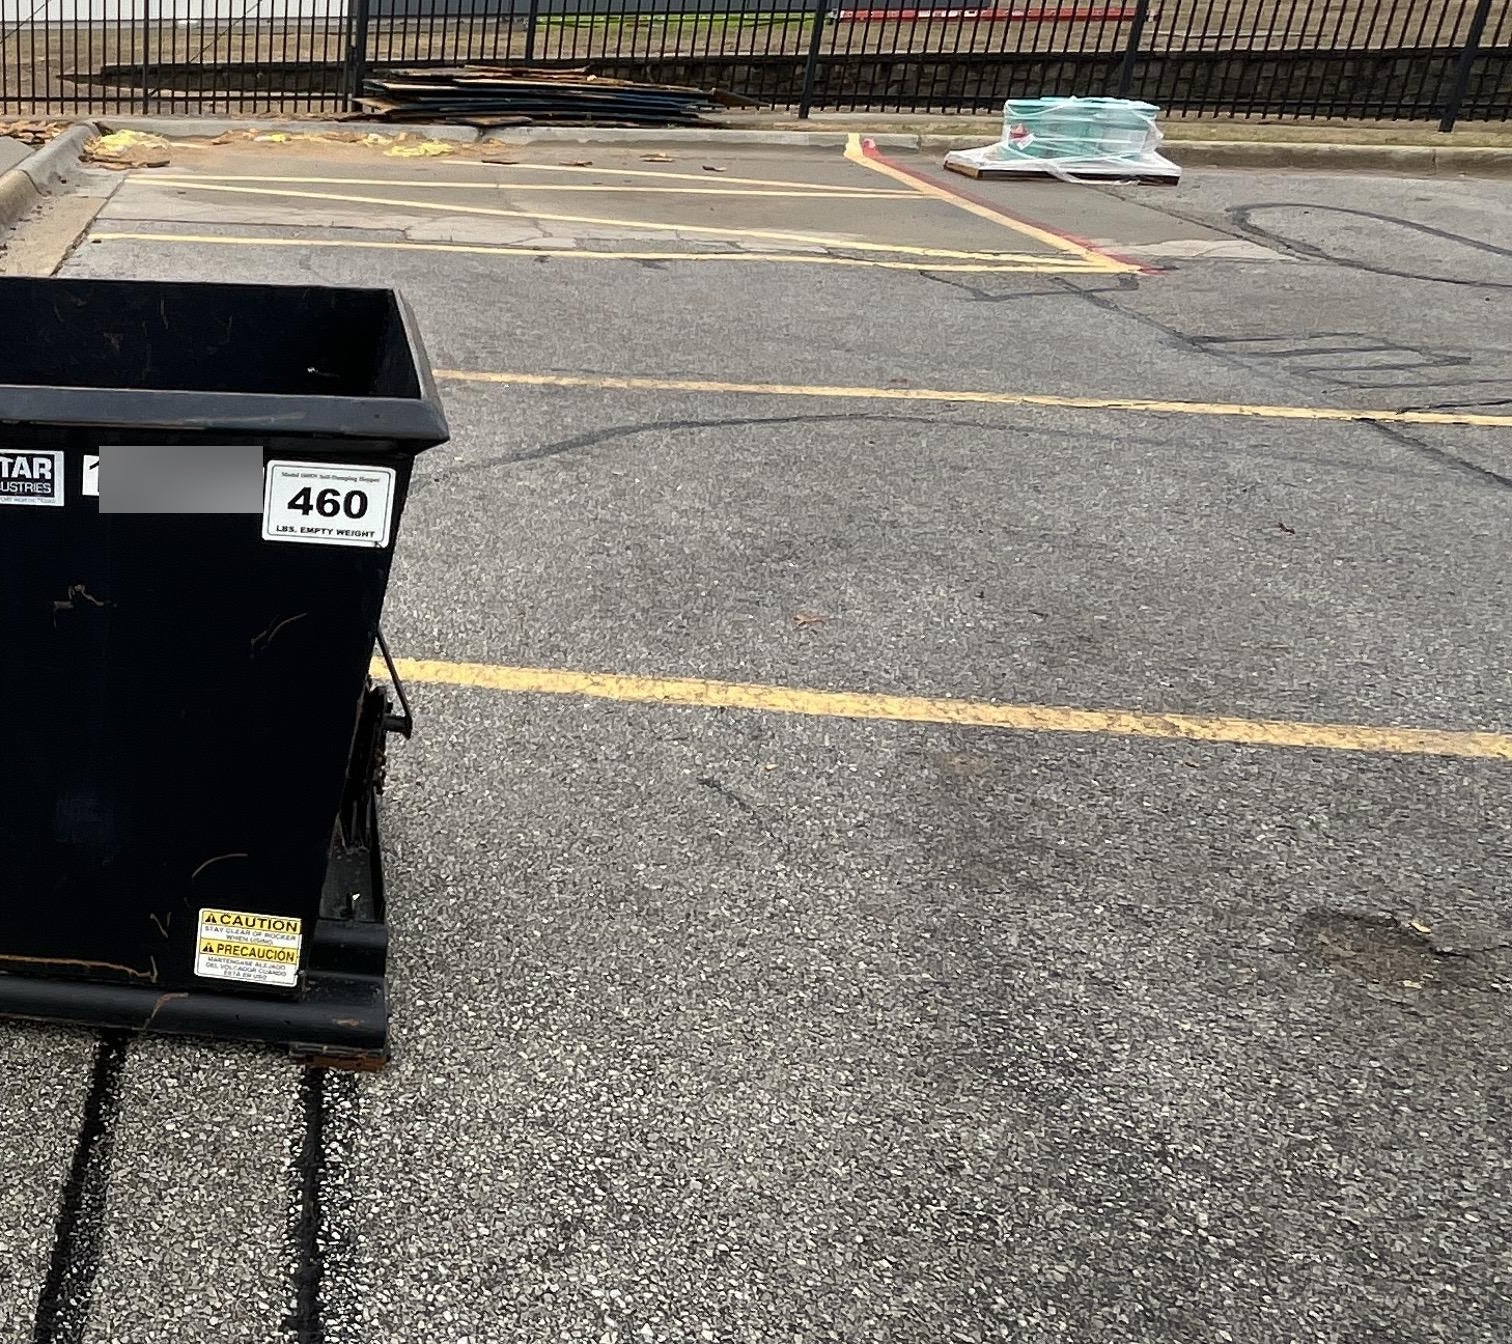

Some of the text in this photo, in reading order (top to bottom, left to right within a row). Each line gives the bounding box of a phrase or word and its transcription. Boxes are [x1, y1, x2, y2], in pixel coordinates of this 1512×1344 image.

[287, 486, 369, 519] 460
[276, 524, 376, 538] LBS. EMPTY WEIGHT
[220, 913, 298, 933] CAUTION
[204, 926, 297, 941] STAY CLEAR OF ROCKER
[226, 934, 249, 943] WHEN
[216, 943, 295, 963] PRECAUCIÓN
[255, 960, 286, 970] ALEJADO
[259, 967, 287, 977] CUANDO
